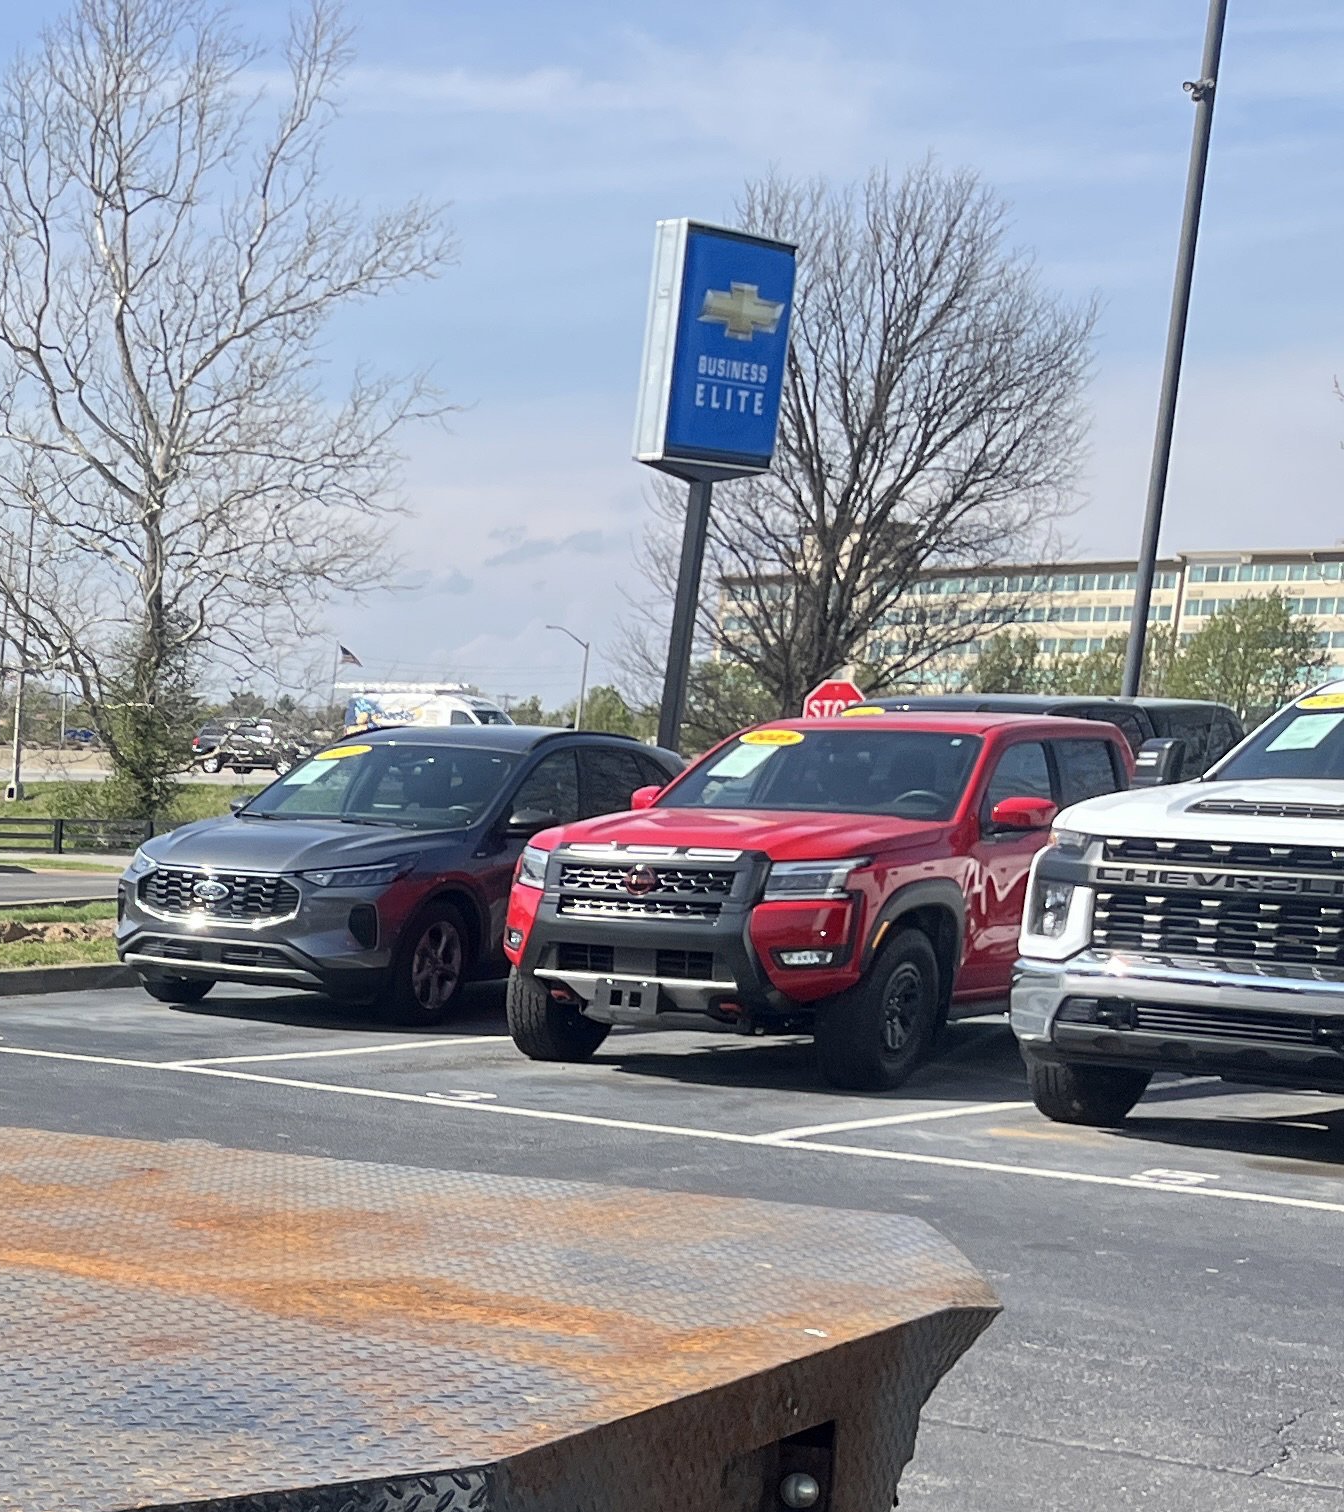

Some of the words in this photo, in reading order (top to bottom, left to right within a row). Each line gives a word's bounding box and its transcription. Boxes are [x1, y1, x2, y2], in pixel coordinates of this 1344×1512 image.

[698, 355, 768, 384] BUSINESS
[695, 384, 764, 415] ELITE
[808, 699, 857, 718] STO
